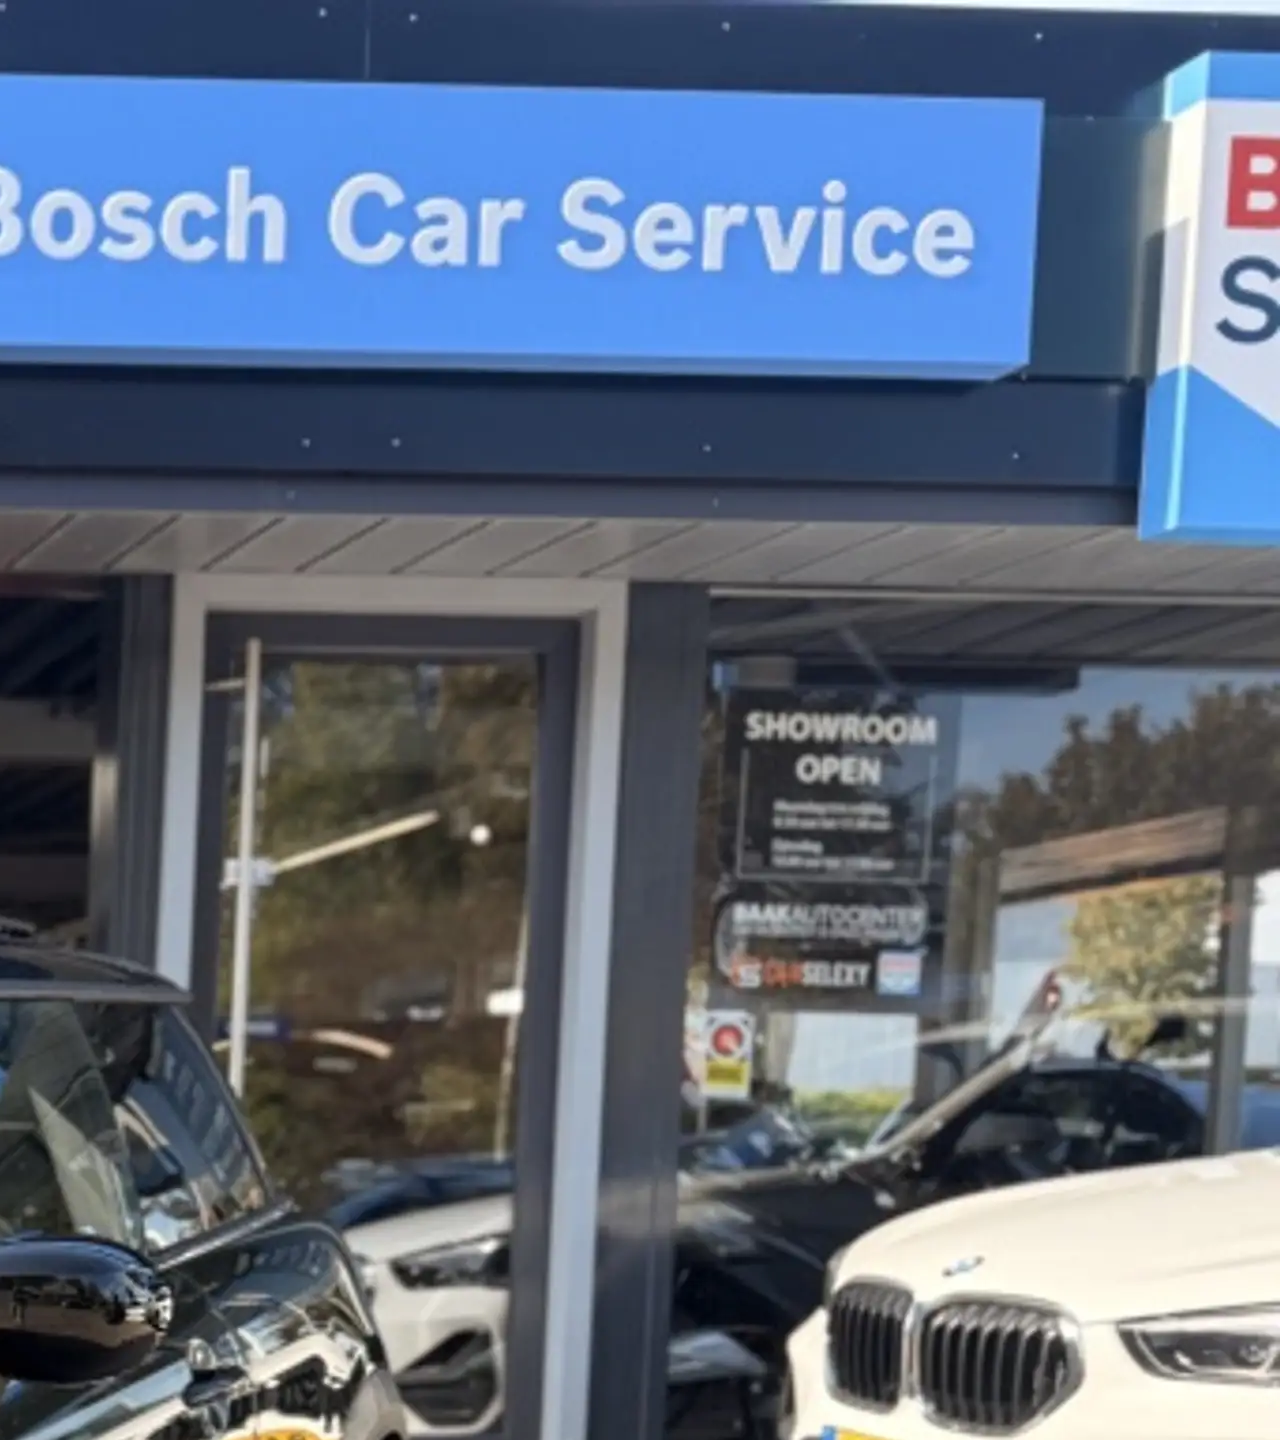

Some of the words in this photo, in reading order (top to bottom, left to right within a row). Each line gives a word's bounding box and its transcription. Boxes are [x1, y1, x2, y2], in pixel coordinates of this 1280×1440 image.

[327, 171, 526, 268] Car
[556, 178, 975, 278] Service
[745, 711, 938, 745] SHOWROOM
[795, 754, 882, 786] OPEN
